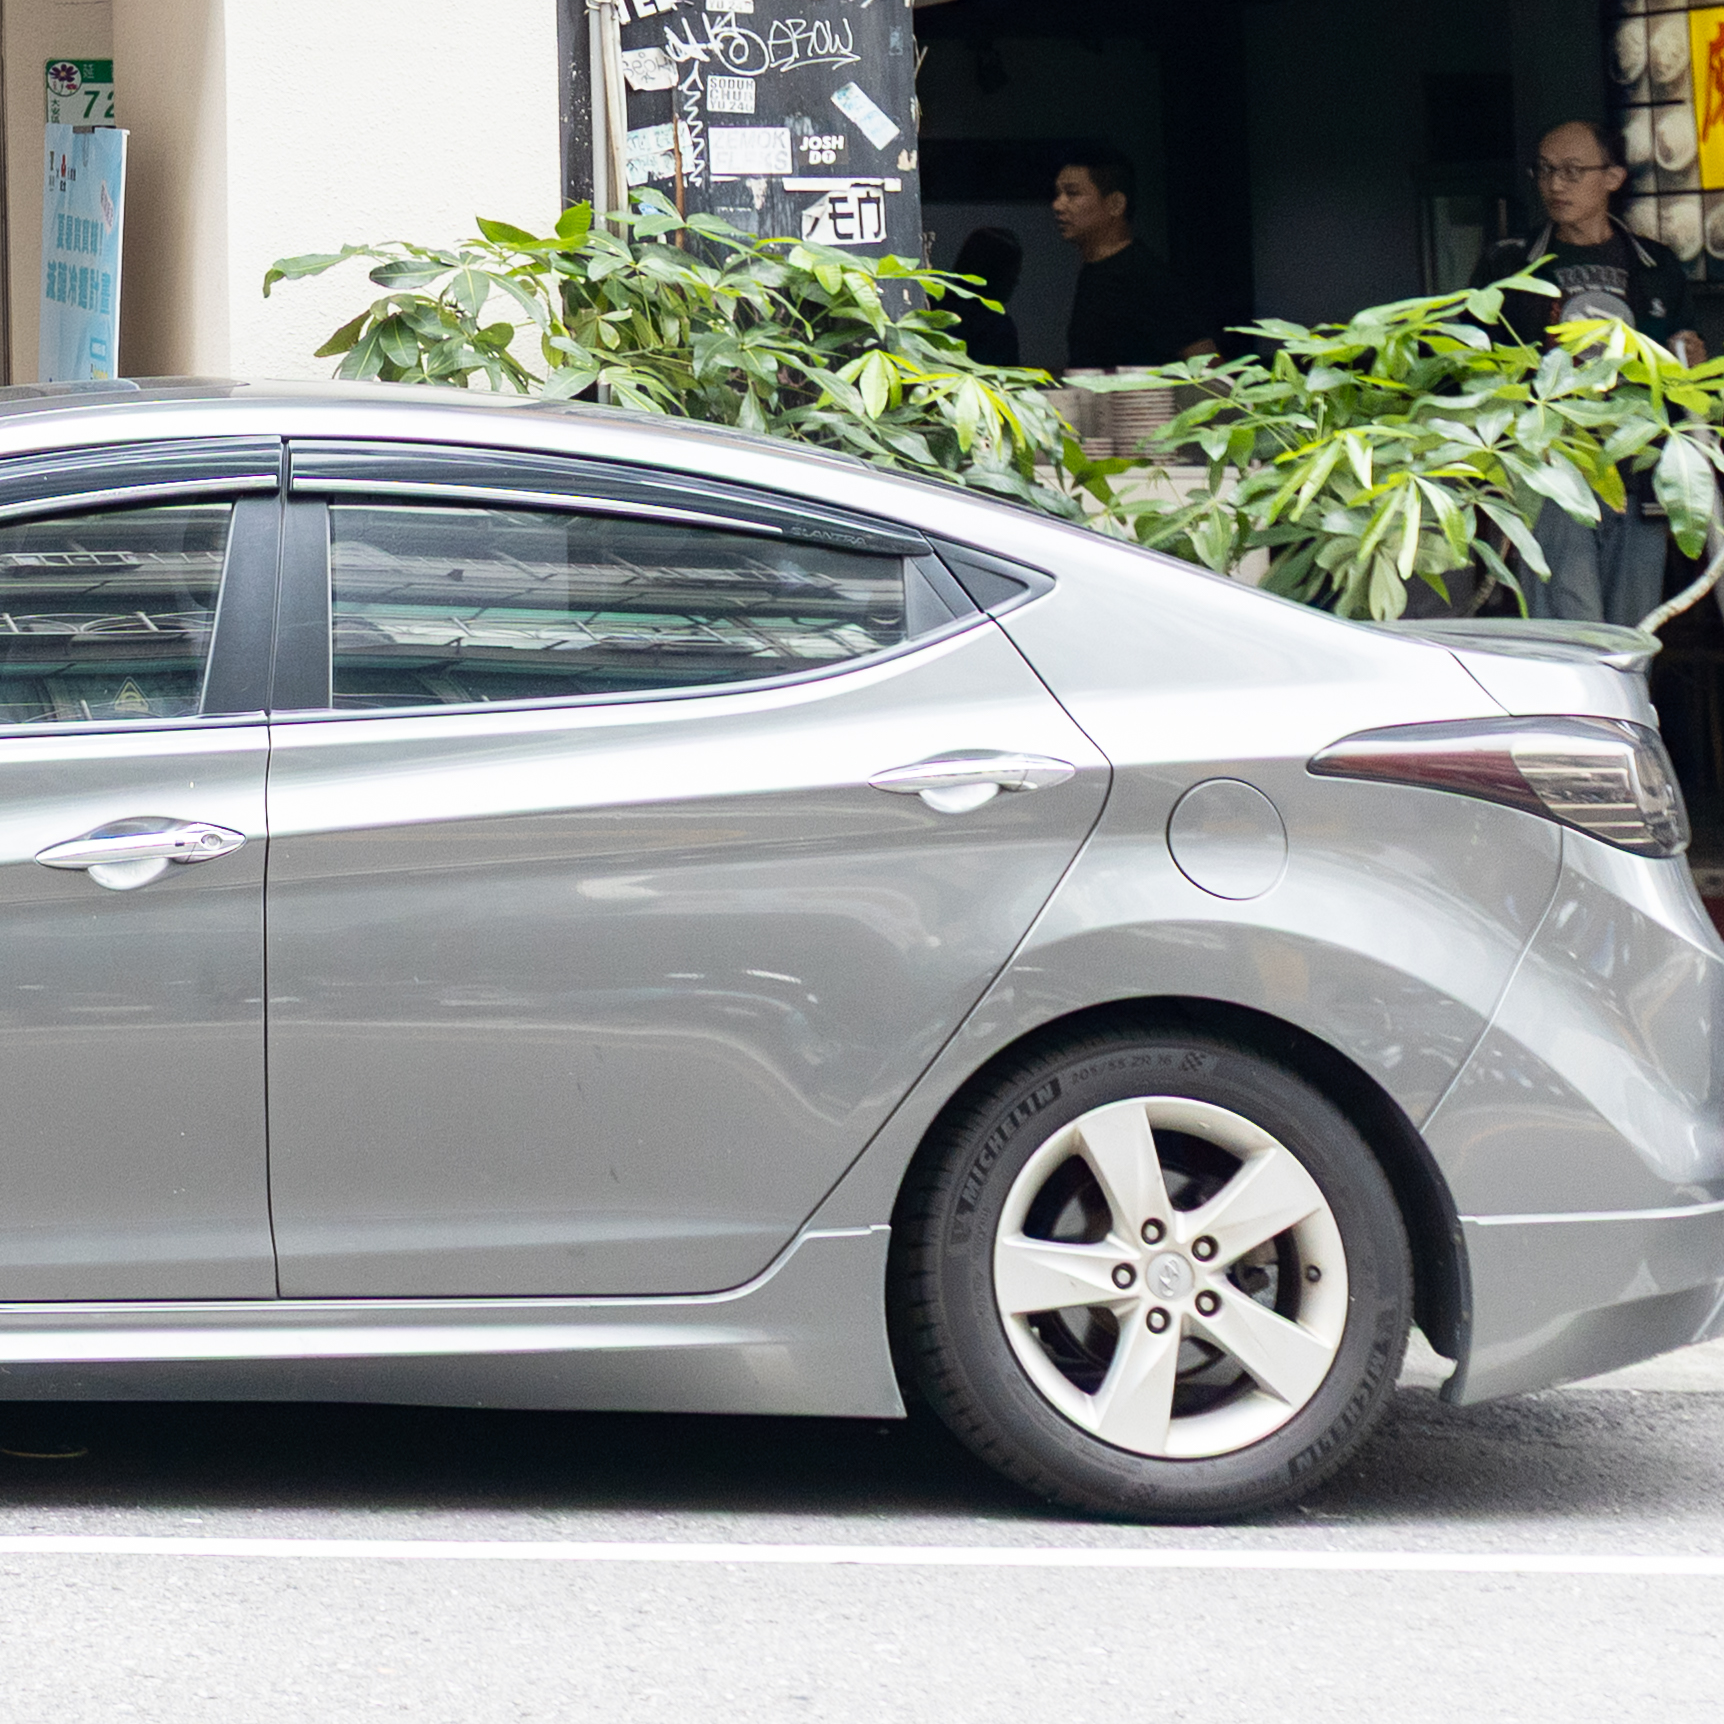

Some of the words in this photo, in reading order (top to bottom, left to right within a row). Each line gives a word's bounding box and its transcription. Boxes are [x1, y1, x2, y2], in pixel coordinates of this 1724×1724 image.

[799, 134, 844, 152] JOSH
[808, 149, 837, 166] DO
[959, 1079, 1060, 1211] MICHELIN
